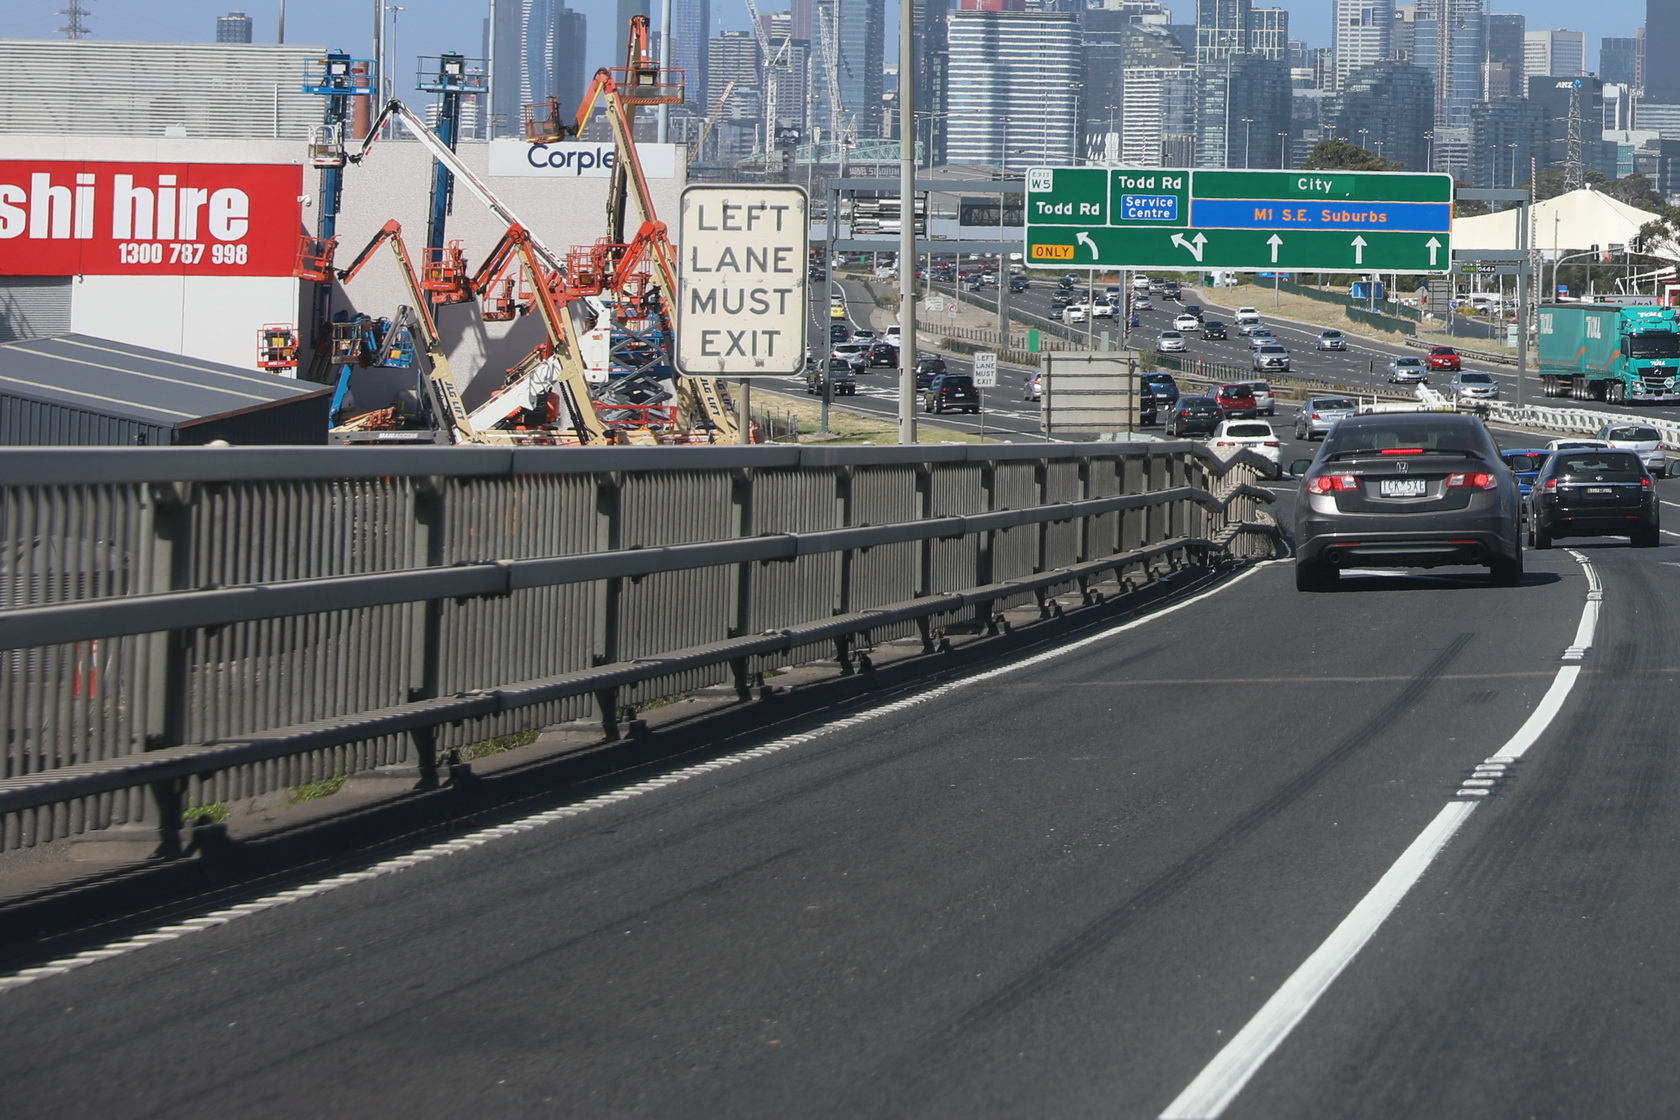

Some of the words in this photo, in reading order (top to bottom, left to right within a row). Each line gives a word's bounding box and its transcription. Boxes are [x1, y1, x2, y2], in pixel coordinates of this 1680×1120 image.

[1555, 81, 1573, 89] ANZ
[1031, 179, 1051, 189] W5
[1118, 175, 1155, 189] Todd
[1162, 177, 1182, 190] Rd
[1297, 177, 1333, 194] City
[0, 172, 96, 240] shi
[112, 173, 249, 241] hire
[1036, 201, 1073, 215] Todd
[1079, 203, 1100, 216] Rd
[1126, 196, 1174, 208] Service
[698, 204, 790, 231] LEFT
[1128, 207, 1170, 219] Centre
[1254, 208, 1273, 221] M1
[1282, 209, 1312, 222] S.E.
[1321, 210, 1387, 223] Suburbs
[118, 242, 163, 264] 1300
[169, 243, 206, 265] 787
[211, 243, 248, 266] 998
[692, 246, 794, 273] LANE
[1036, 246, 1070, 257] ONLY
[691, 287, 793, 315] MUST
[700, 330, 781, 357] EXIT
[1650, 358, 1666, 366] TOLL
[444, 381, 456, 398] JLG
[451, 400, 465, 421] LIFT
[700, 377, 712, 393] JLG
[707, 397, 720, 416] LIFT
[720, 393, 734, 412] LIFT
